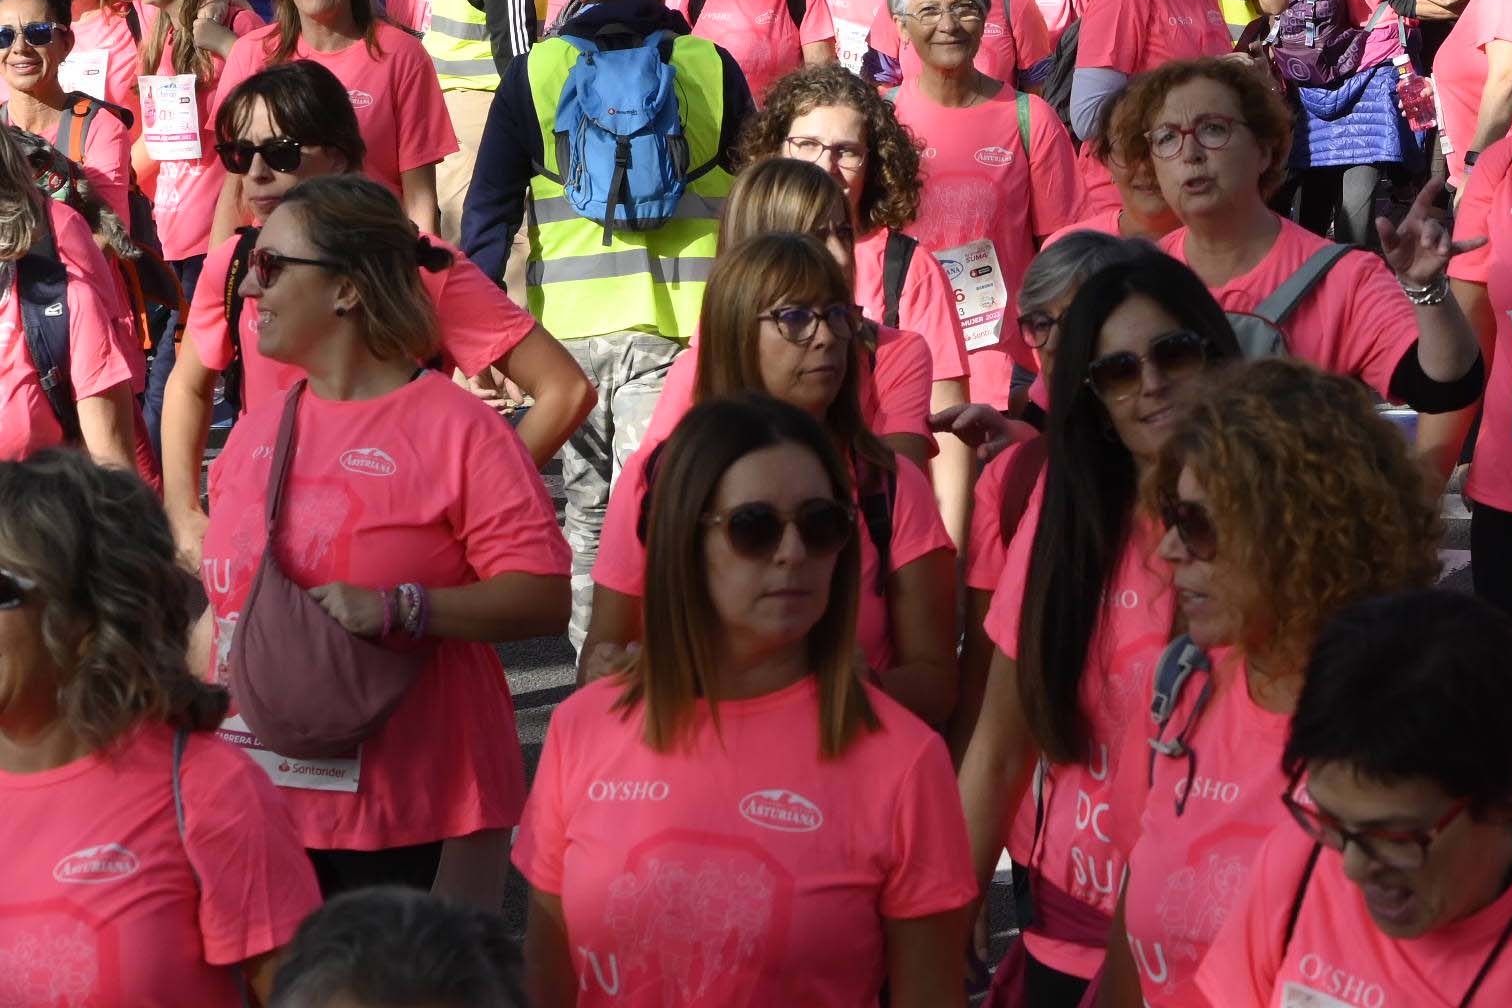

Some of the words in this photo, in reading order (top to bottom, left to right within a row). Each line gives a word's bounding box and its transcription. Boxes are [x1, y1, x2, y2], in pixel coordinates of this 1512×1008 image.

[292, 762, 346, 778] Santander
[588, 780, 670, 802] OYSHO
[746, 798, 816, 826] ASTURIANA
